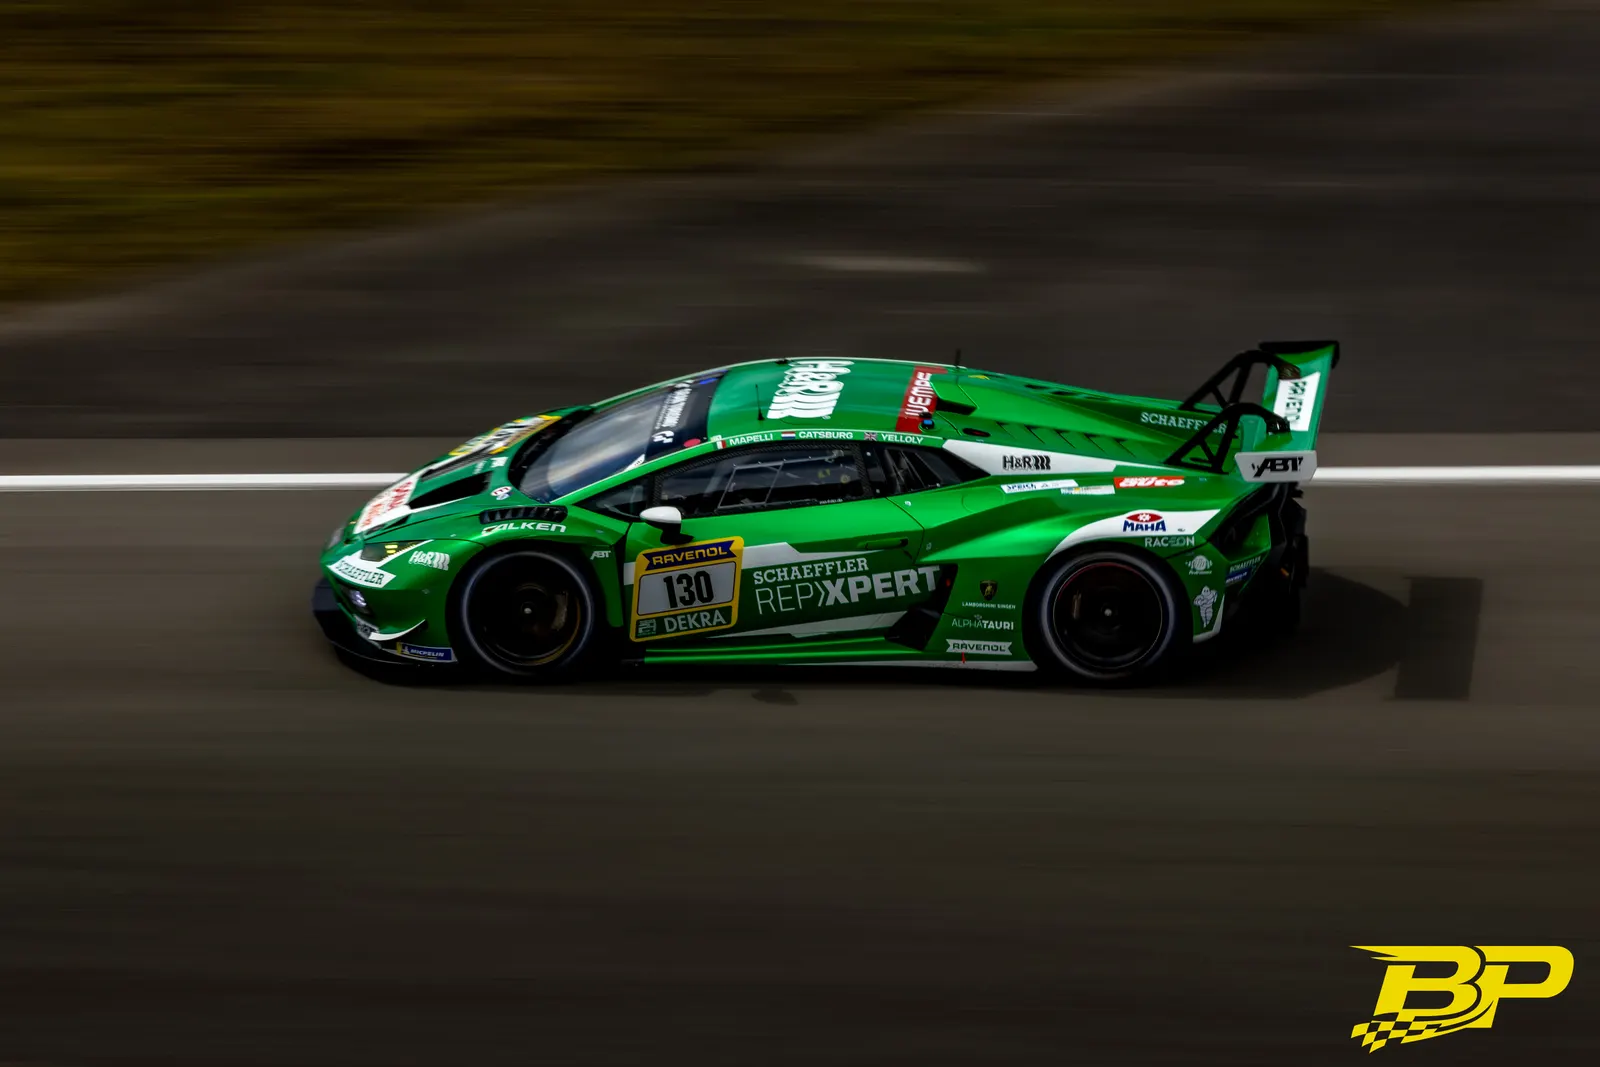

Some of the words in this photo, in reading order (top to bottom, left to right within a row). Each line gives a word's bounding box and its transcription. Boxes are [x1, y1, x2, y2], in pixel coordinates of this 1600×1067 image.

[1140, 411, 1227, 435] SCHAEFFR
[729, 433, 774, 446] MAPELLI
[798, 431, 854, 440] CATSBURG
[881, 433, 924, 445] YELLOLY
[1002, 455, 1033, 471] H&R
[1254, 456, 1303, 478] ABT
[481, 522, 567, 537] FALKEN
[1122, 519, 1167, 533] MAHA
[652, 546, 728, 566] RAVENOL
[335, 560, 386, 586] SCHAEFFLER
[752, 557, 870, 585] SCHAEFFLER
[663, 570, 715, 609] 130
[961, 601, 997, 609] LAMBORGHINI
[664, 609, 727, 633] DEKRA
[951, 618, 1015, 631] ALPHATAURI
[952, 642, 1007, 652] RAVENOL
